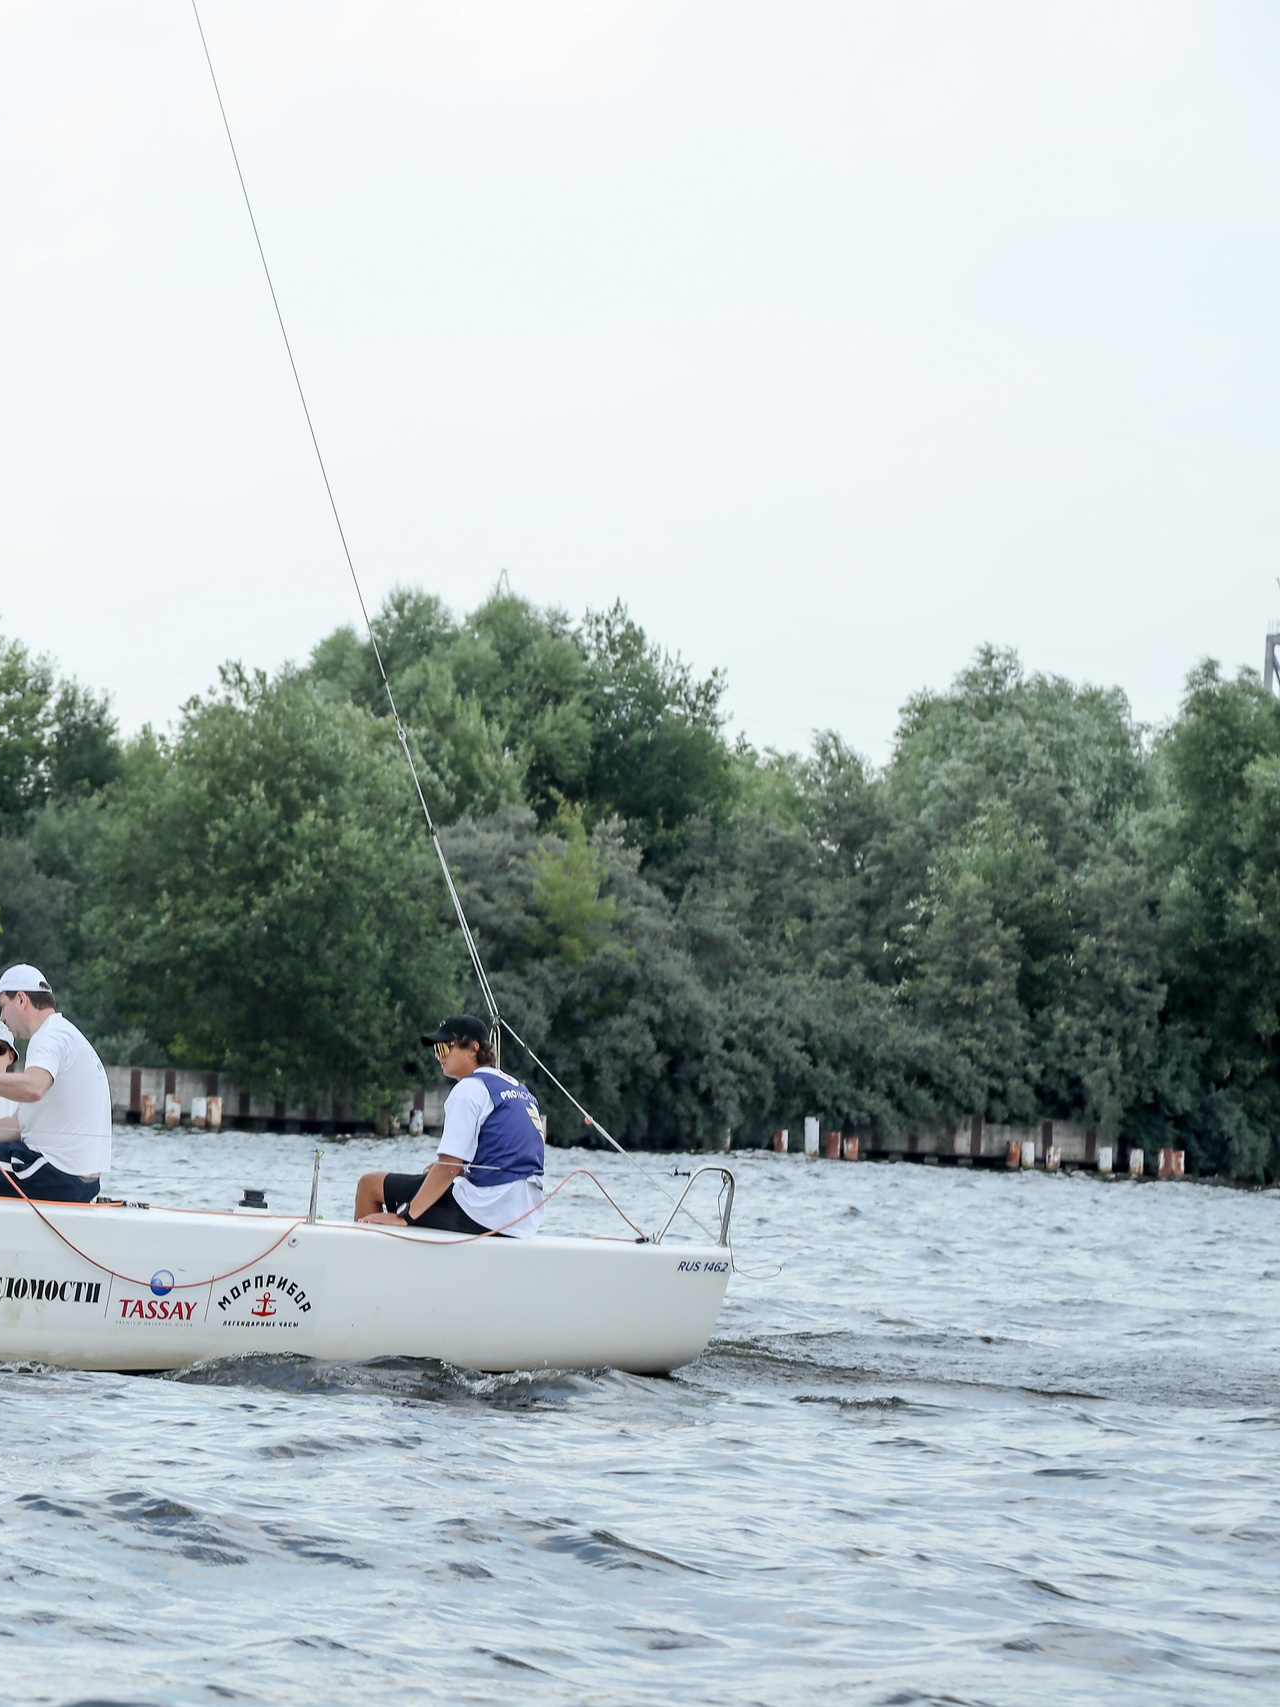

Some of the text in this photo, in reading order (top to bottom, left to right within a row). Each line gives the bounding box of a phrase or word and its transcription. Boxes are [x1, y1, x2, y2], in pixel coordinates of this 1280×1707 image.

[677, 1261, 729, 1272] RUS 1462
[217, 1274, 312, 1313] МОРПРИБОР
[119, 1298, 198, 1320] TASSAY
